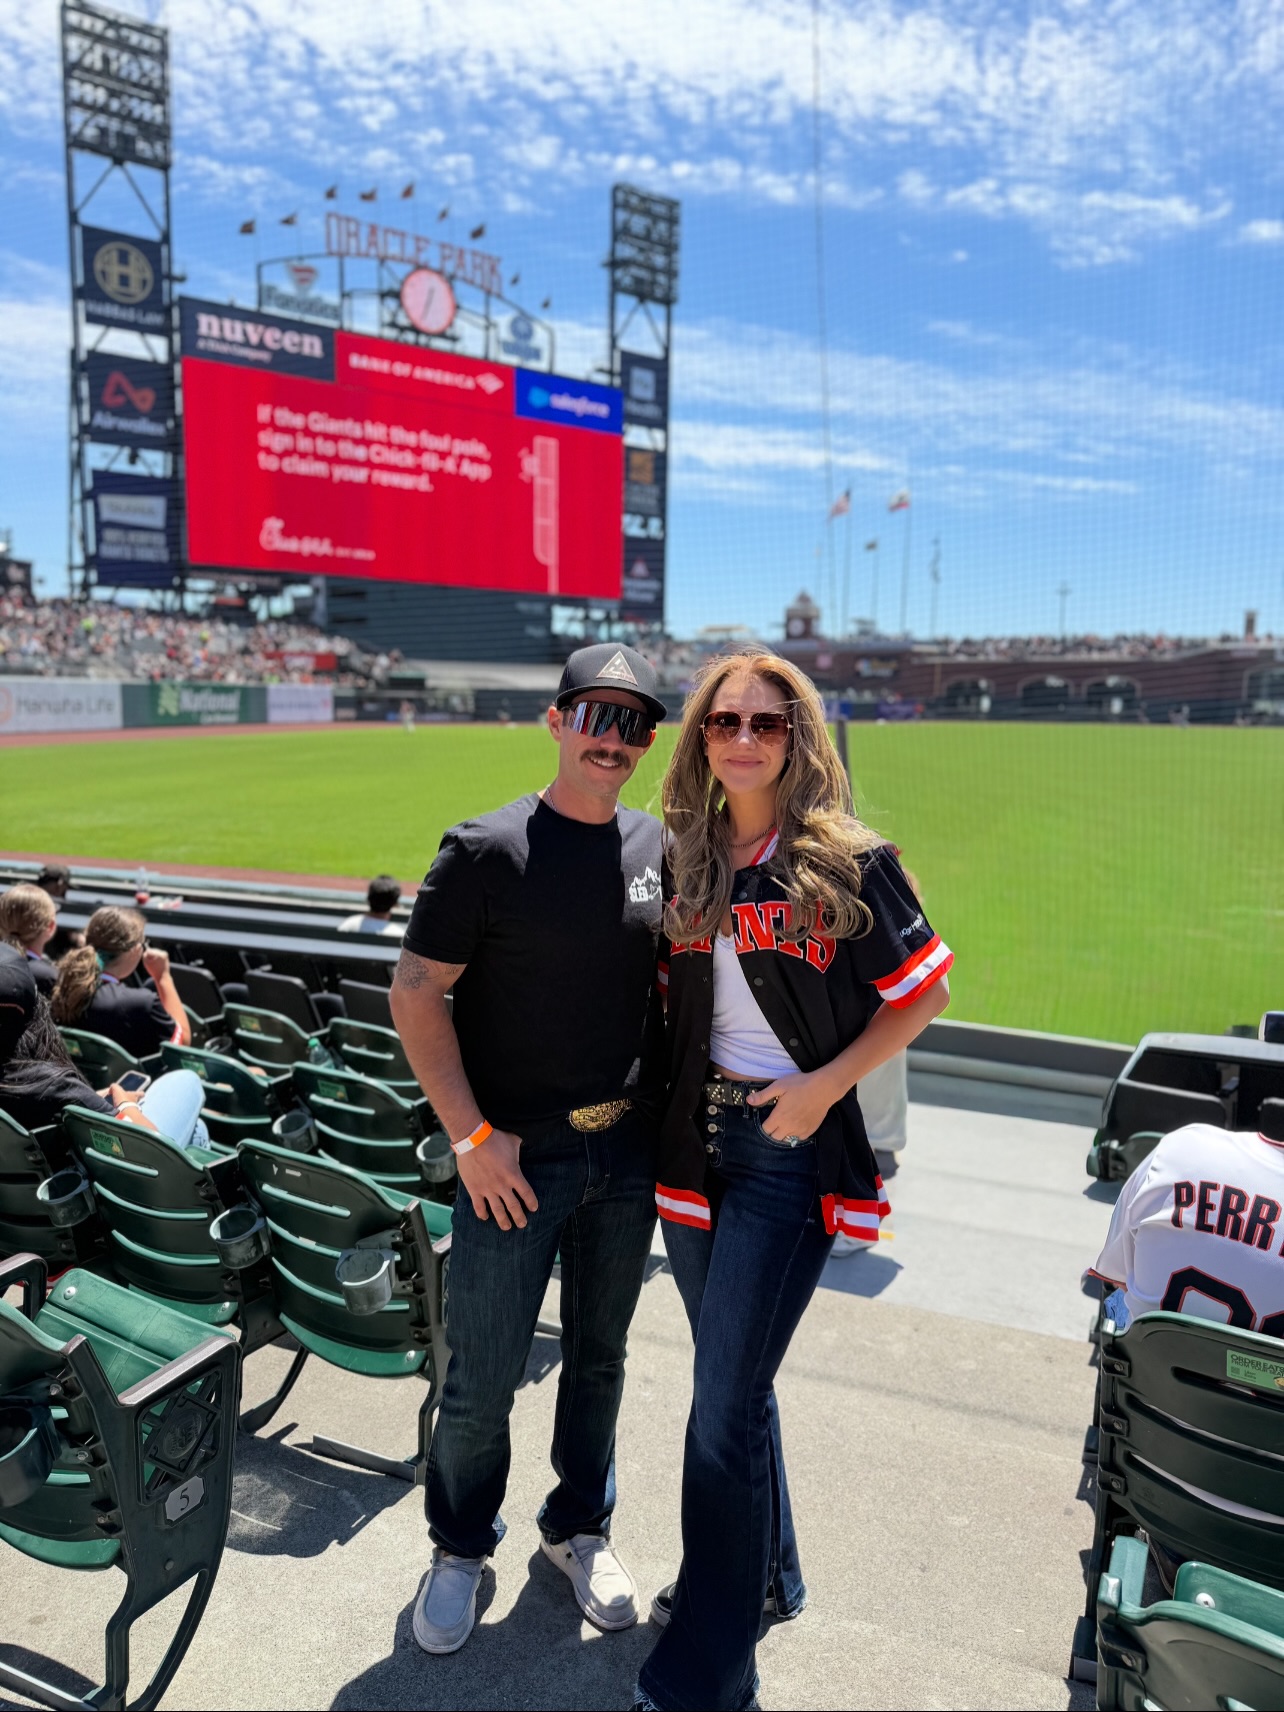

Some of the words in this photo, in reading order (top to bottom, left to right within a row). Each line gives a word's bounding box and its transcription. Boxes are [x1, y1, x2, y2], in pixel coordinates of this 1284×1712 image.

[326, 212, 429, 267] ORACLE
[439, 241, 502, 299] PARK
[196, 313, 324, 359] nuveen
[349, 352, 389, 373] BANK
[391, 362, 411, 378] OF
[412, 365, 476, 390] AMERICA
[257, 403, 272, 423] If
[274, 406, 306, 429] the
[307, 411, 362, 439] Giants
[364, 420, 388, 442] hit
[389, 425, 418, 448] the
[420, 429, 451, 452] foul
[257, 450, 280, 472] to
[281, 453, 330, 479] claim
[331, 463, 370, 484] your
[371, 469, 434, 492] reward.
[258, 428, 294, 454] sign
[296, 432, 314, 453] in
[315, 435, 336, 457] to
[337, 439, 367, 462] the
[459, 457, 492, 483] App
[1171, 1181, 1284, 1258] PERR
[1231, 1354, 1262, 1367] ORDER
[180, 1487, 190, 1511] 5
